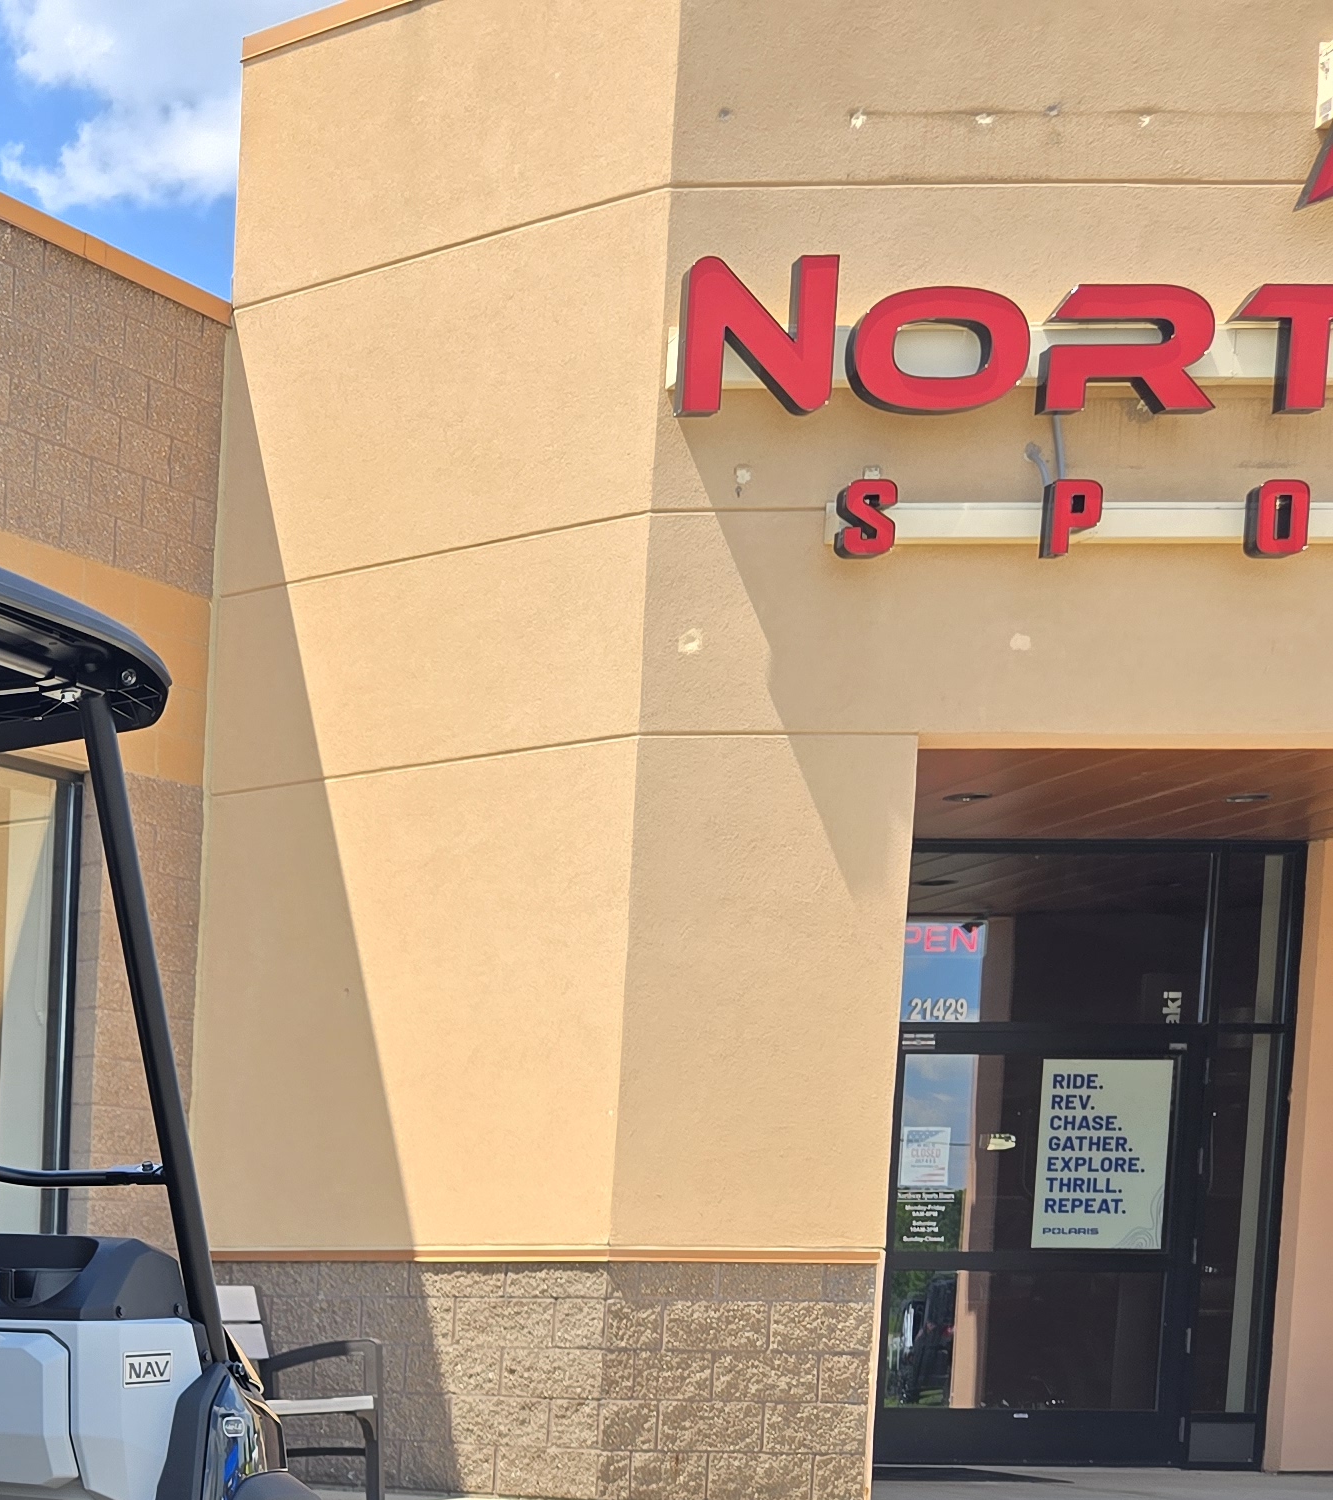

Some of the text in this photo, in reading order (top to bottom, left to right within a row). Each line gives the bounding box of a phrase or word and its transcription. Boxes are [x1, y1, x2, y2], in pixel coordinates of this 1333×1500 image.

[910, 998, 968, 1021] 21429
[1052, 1074, 1104, 1090] RIDE.
[1051, 1094, 1095, 1111] REV.
[1049, 1115, 1122, 1131] CHASE.
[1048, 1136, 1133, 1152] GATHER.
[911, 1148, 941, 1158] CLOSED
[1046, 1157, 1145, 1173] EXPLORE.
[1046, 1177, 1122, 1193] THRILL.
[1044, 1198, 1126, 1214] REPEAT.
[1042, 1227, 1099, 1235] POLARIS
[128, 1360, 170, 1379] NAV
